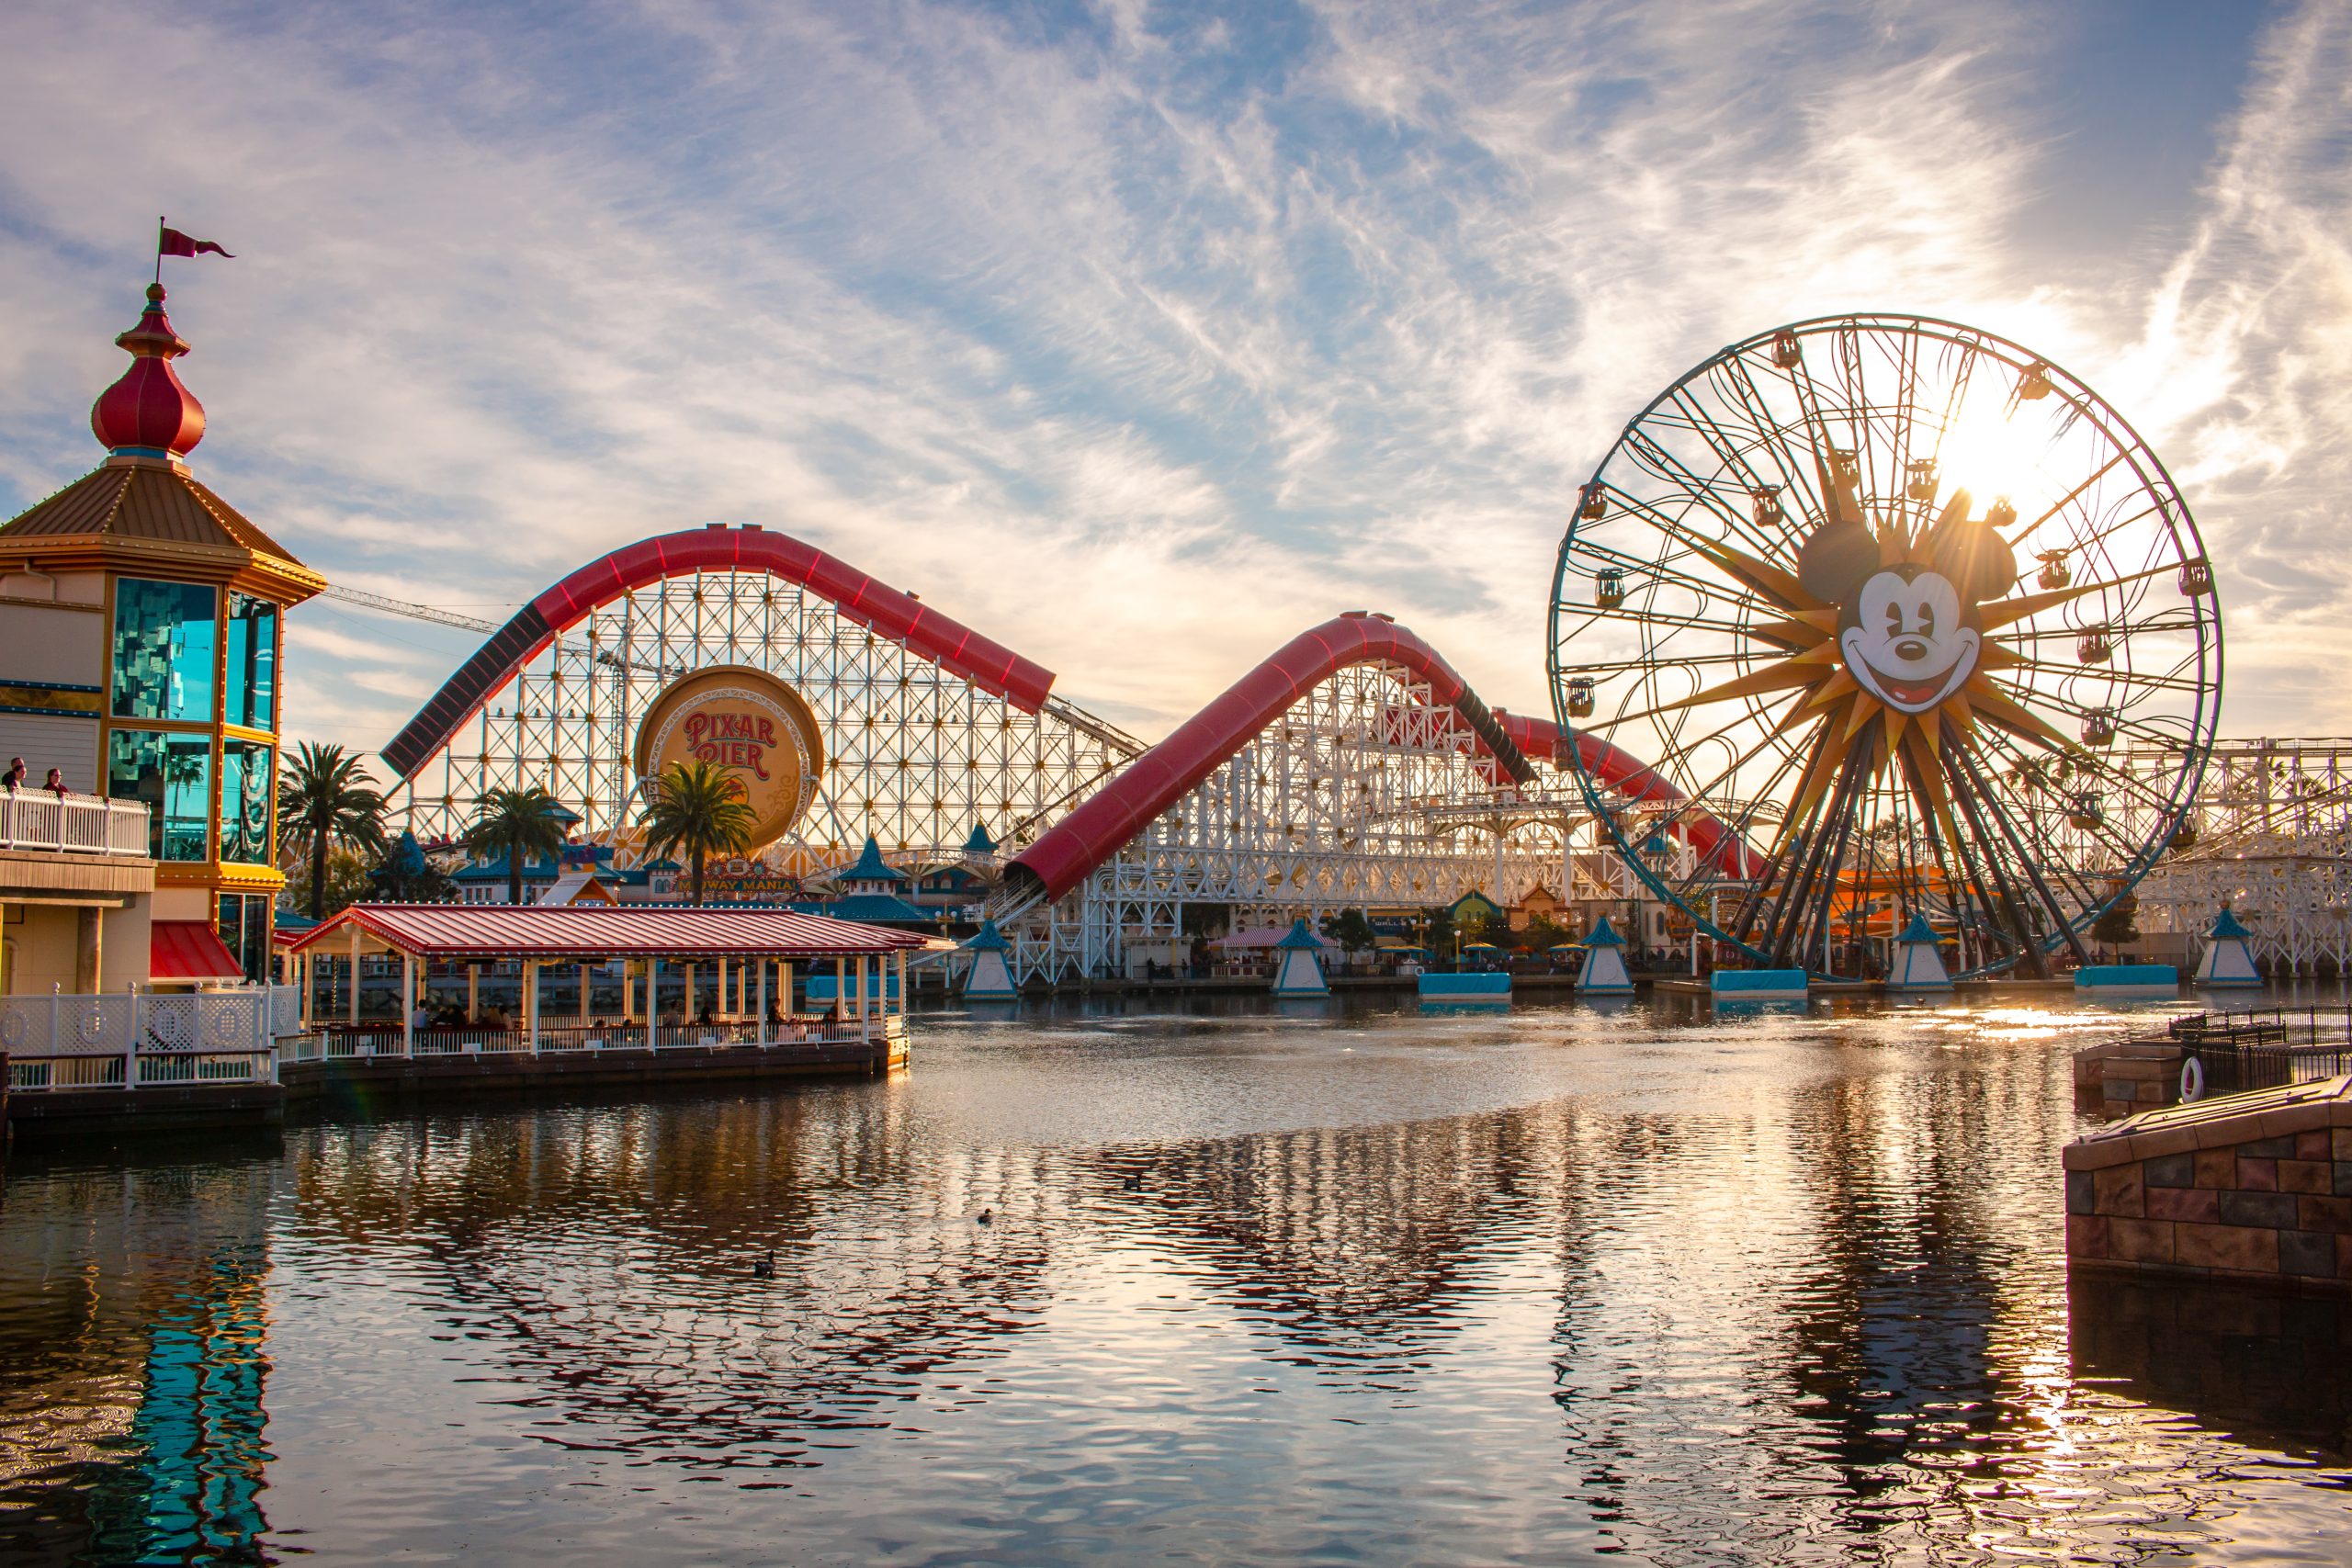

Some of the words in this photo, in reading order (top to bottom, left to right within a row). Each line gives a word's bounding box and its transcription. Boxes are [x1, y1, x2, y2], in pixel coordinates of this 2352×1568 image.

[684, 712, 777, 750] PIXAR
[694, 741, 770, 781] PIER
[679, 881, 736, 890] MWAY
[742, 881, 797, 890] MANIA!
